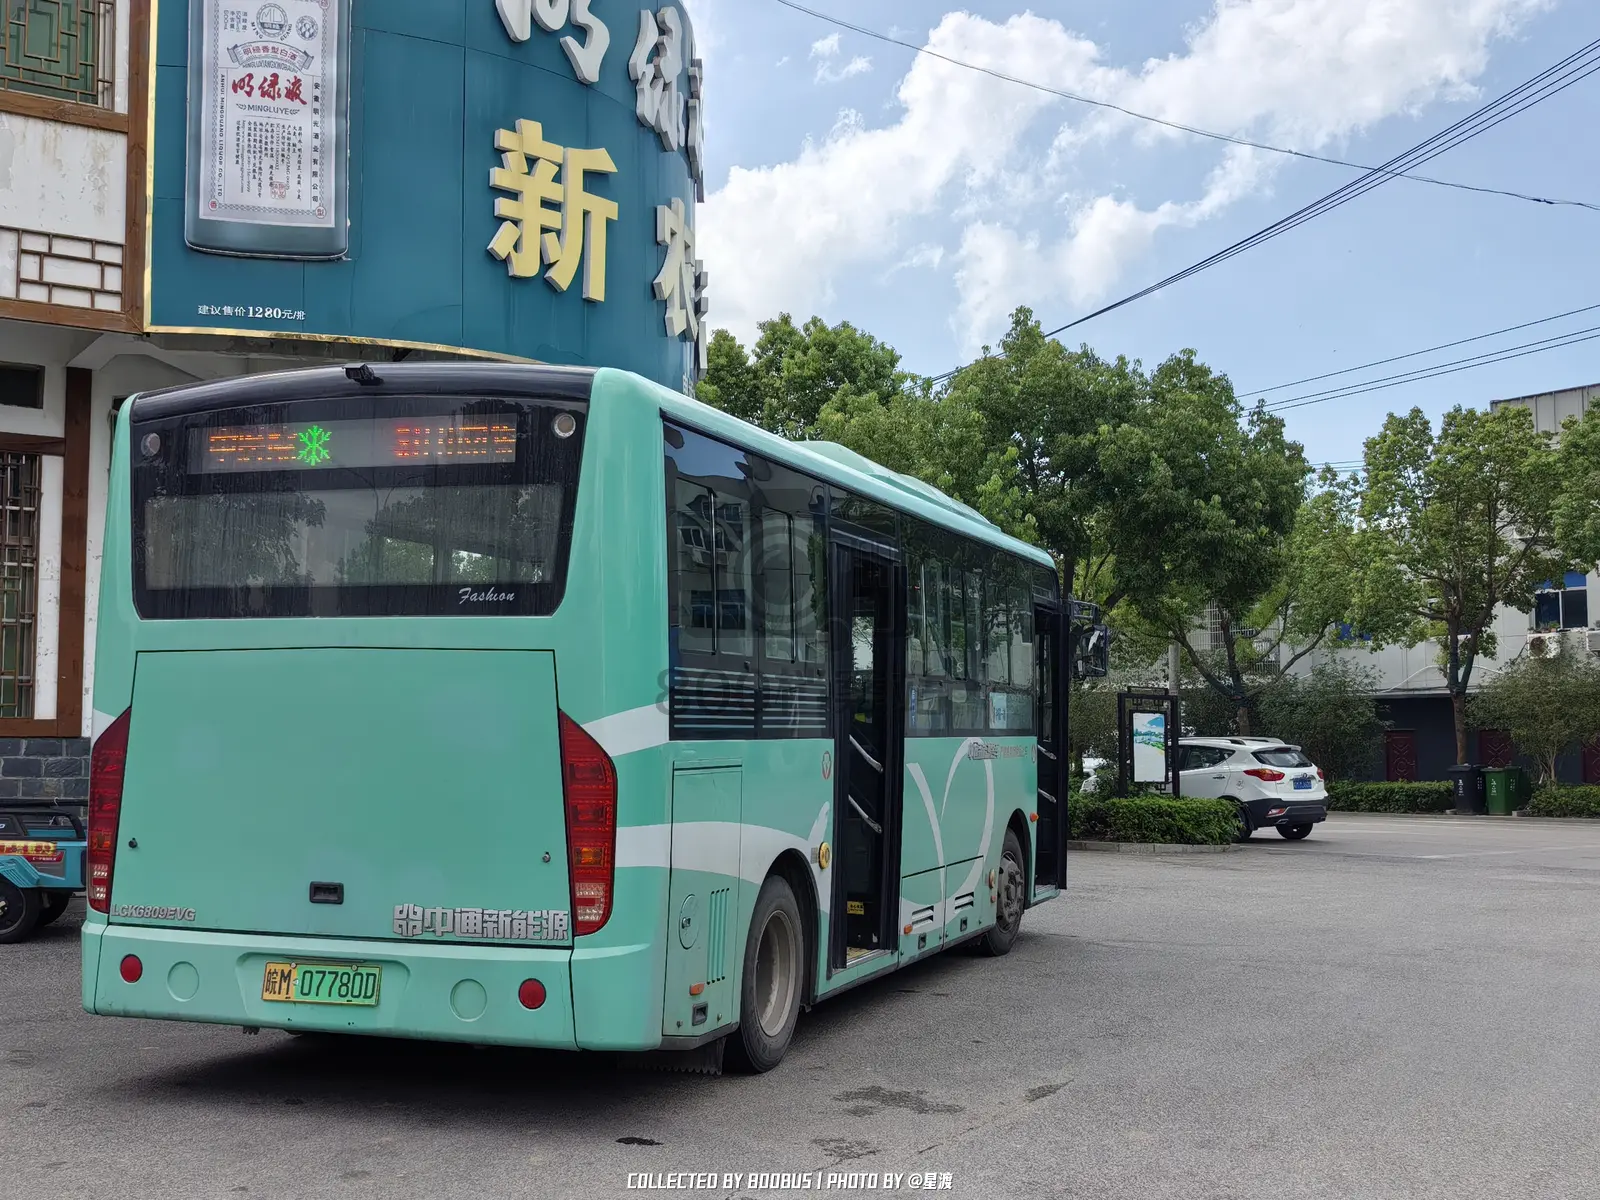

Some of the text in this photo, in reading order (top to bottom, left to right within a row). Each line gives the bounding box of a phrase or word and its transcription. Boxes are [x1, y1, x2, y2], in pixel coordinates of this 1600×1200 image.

[247, 104, 290, 115] MINGLUYE
[458, 586, 515, 605] Fashion
[111, 904, 196, 921] LCK6809EVG
[424, 906, 569, 941] 中通新能源
